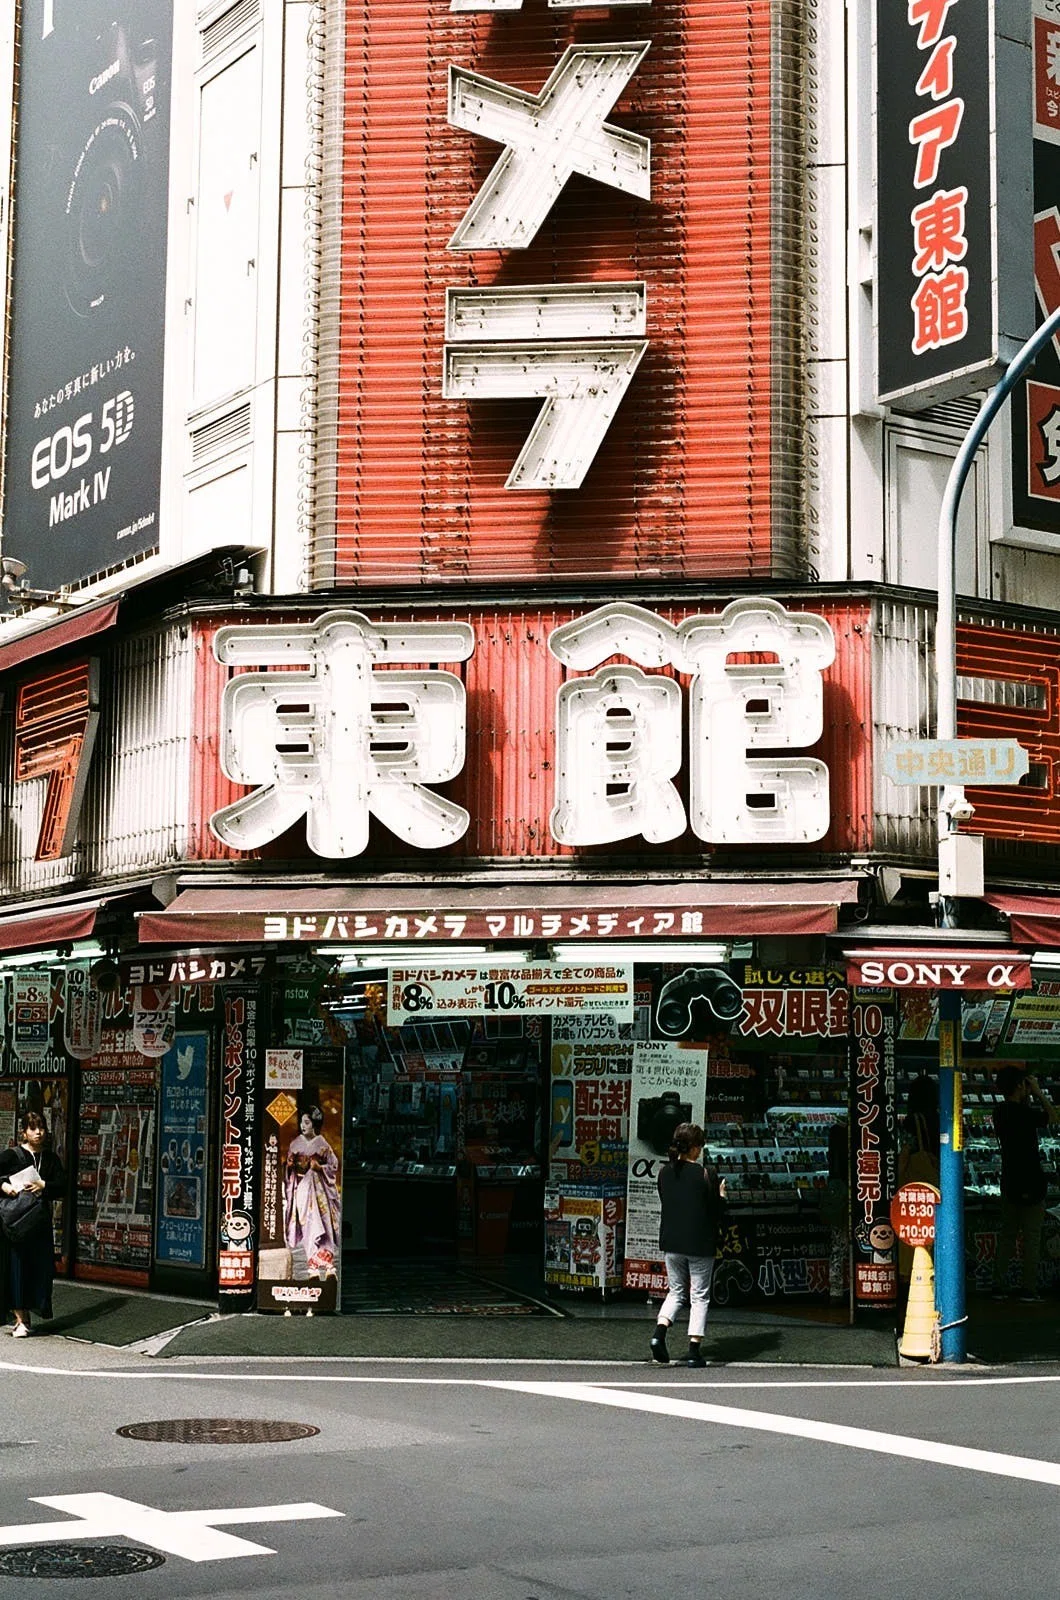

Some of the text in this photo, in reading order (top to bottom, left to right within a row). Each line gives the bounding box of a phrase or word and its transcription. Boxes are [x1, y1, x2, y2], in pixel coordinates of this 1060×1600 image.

[89, 59, 120, 95] Canon
[442, 0, 653, 490] メラ
[34, 346, 135, 418] あなたの写真に新しい力を。
[32, 390, 134, 490] EOS 5D
[50, 466, 111, 527] Mark IV
[208, 597, 836, 860] 東館
[895, 747, 1015, 777] 中央通り
[264, 911, 704, 941] ヨドバシカメラ マルチメディア館
[129, 957, 267, 984] ヨドバシカメラ
[861, 961, 1016, 987] SONY α
[464, 985, 485, 995] しかも
[553, 1014, 614, 1027] カメラも テレビも
[577, 1027, 616, 1040] パソコンも
[636, 1042, 668, 1050] SONY
[9, 1052, 67, 1074] Information
[640, 1077, 698, 1087] ここから始まる
[909, 1204, 934, 1217] 9:30
[906, 1225, 936, 1238] 10:00
[858, 1270, 896, 1282] 新規会員
[862, 1282, 892, 1293] 募集中
